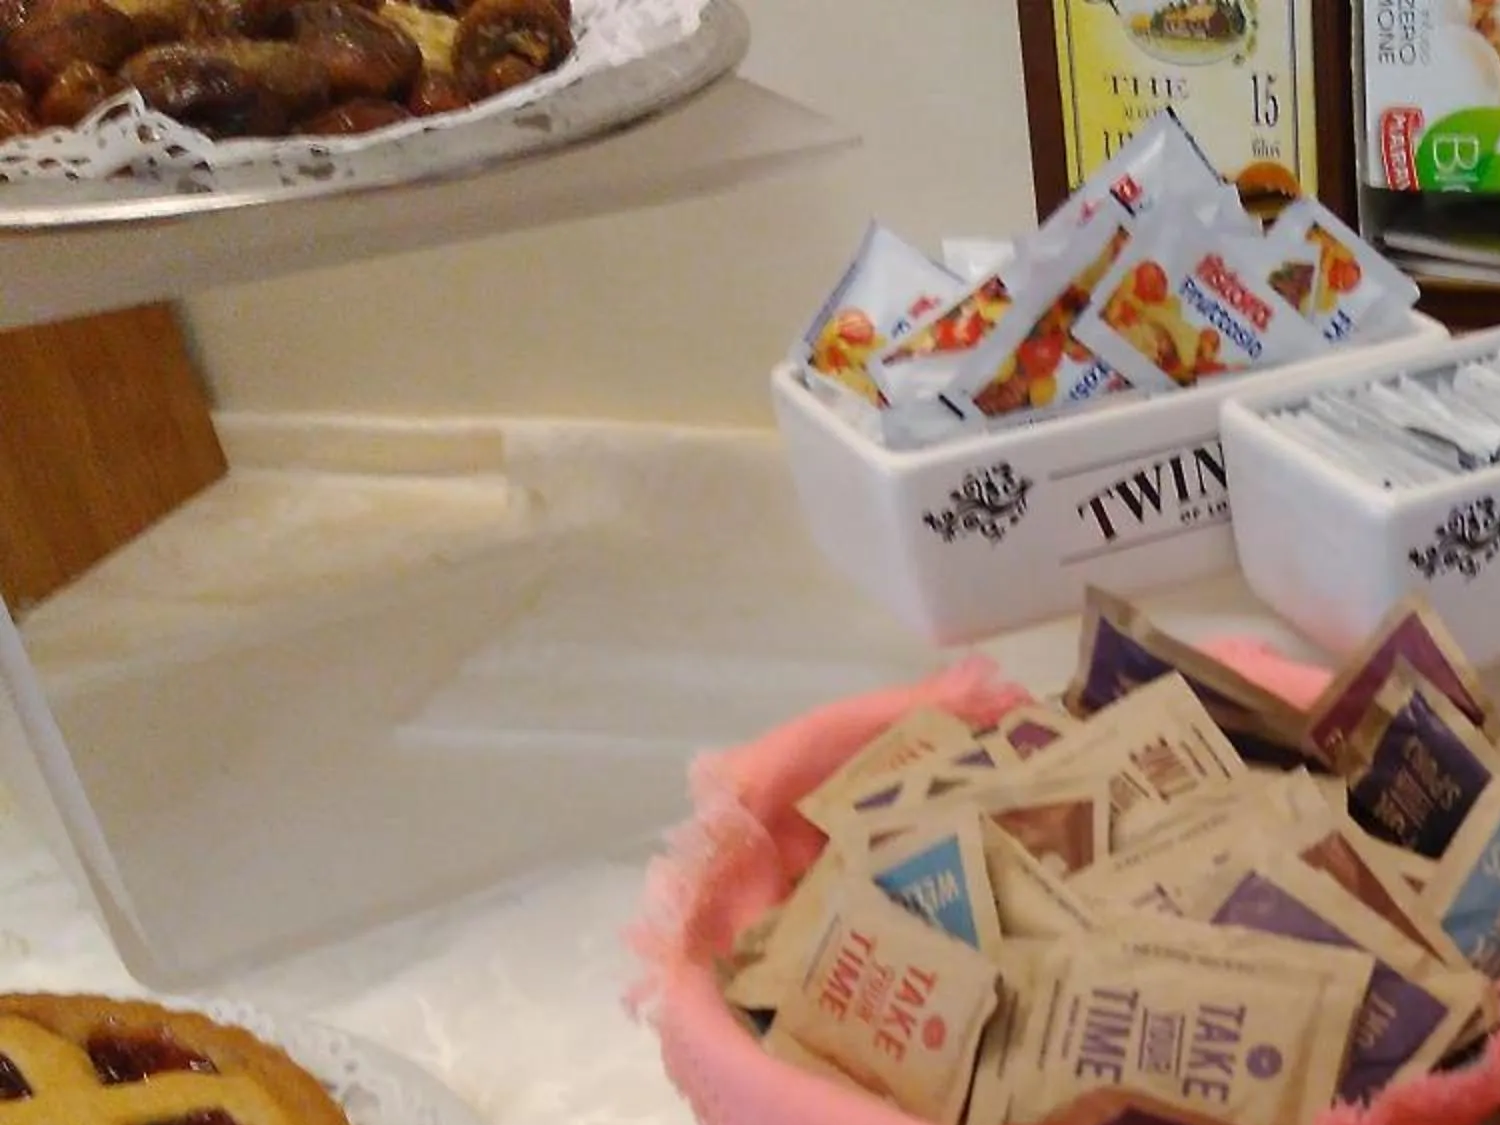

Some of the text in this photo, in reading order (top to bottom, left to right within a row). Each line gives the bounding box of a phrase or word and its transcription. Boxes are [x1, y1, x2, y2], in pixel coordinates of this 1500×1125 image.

[1251, 73, 1280, 128] 15
[819, 928, 876, 1022] TIME
[874, 963, 938, 1063] TAKE
[1075, 987, 1140, 1085] TIME
[1182, 1001, 1247, 1104] TAKE
